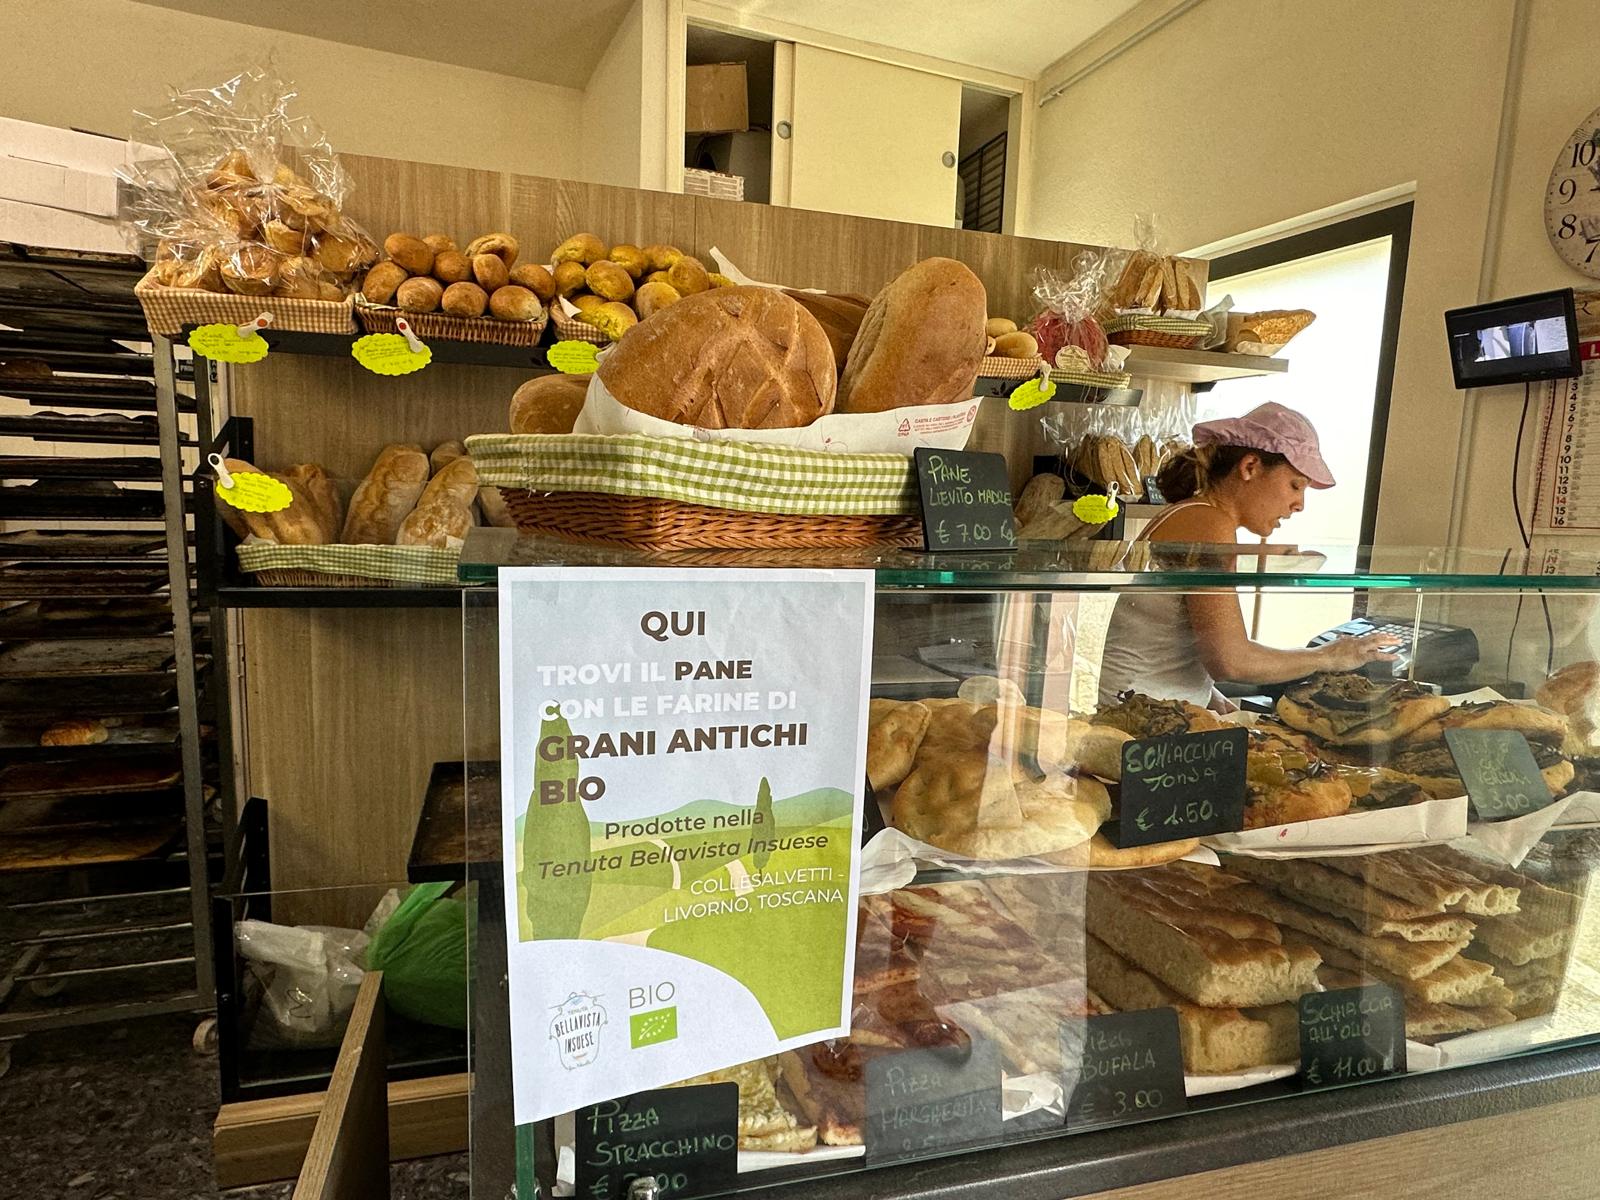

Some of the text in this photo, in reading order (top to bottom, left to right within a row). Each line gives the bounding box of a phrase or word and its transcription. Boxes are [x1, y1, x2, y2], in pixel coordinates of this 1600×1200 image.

[1572, 140, 1596, 168] 10
[1559, 179, 1577, 205] 9
[1558, 214, 1577, 239] 8
[1585, 238, 1600, 263] 7
[1571, 383, 1578, 391] 3
[1568, 414, 1575, 422] 6
[1568, 424, 1573, 432] 7
[1564, 445, 1571, 454] 9
[1566, 435, 1572, 443] 8
[928, 454, 971, 484] PANE
[1560, 455, 1571, 464] 10
[1560, 466, 1569, 474] 11
[1558, 486, 1568, 494] 13
[1559, 476, 1569, 484] 12
[930, 486, 973, 506] LIEVITO
[1556, 497, 1566, 505] 14
[1554, 517, 1564, 525] 16
[1556, 507, 1565, 515] 15
[936, 520, 950, 543] €
[956, 524, 991, 543] 7.00
[640, 610, 706, 642] QUI
[537, 660, 753, 686] TROVI IL PANE
[538, 690, 796, 722] CON LE FARINE DI
[539, 722, 808, 762] GRANI ANTICHI
[540, 776, 606, 806] BIO
[606, 808, 764, 840] Prodotte nella
[1135, 807, 1153, 831] €
[538, 834, 829, 880] Tenuta Bellavista Insuese
[690, 868, 832, 896] COLLESALVETTI
[664, 888, 844, 923] LIVORNO, TOSCANA
[629, 982, 675, 1009] BIO
[554, 1012, 601, 1037] BELLAVISTA
[564, 1031, 595, 1054] INSUESE
[1080, 1048, 1156, 1083] BUFALA
[1308, 1058, 1322, 1084] €
[1112, 1090, 1163, 1117] 3.00
[586, 1134, 735, 1166] STRACCHINO
[590, 1174, 610, 1200] €
